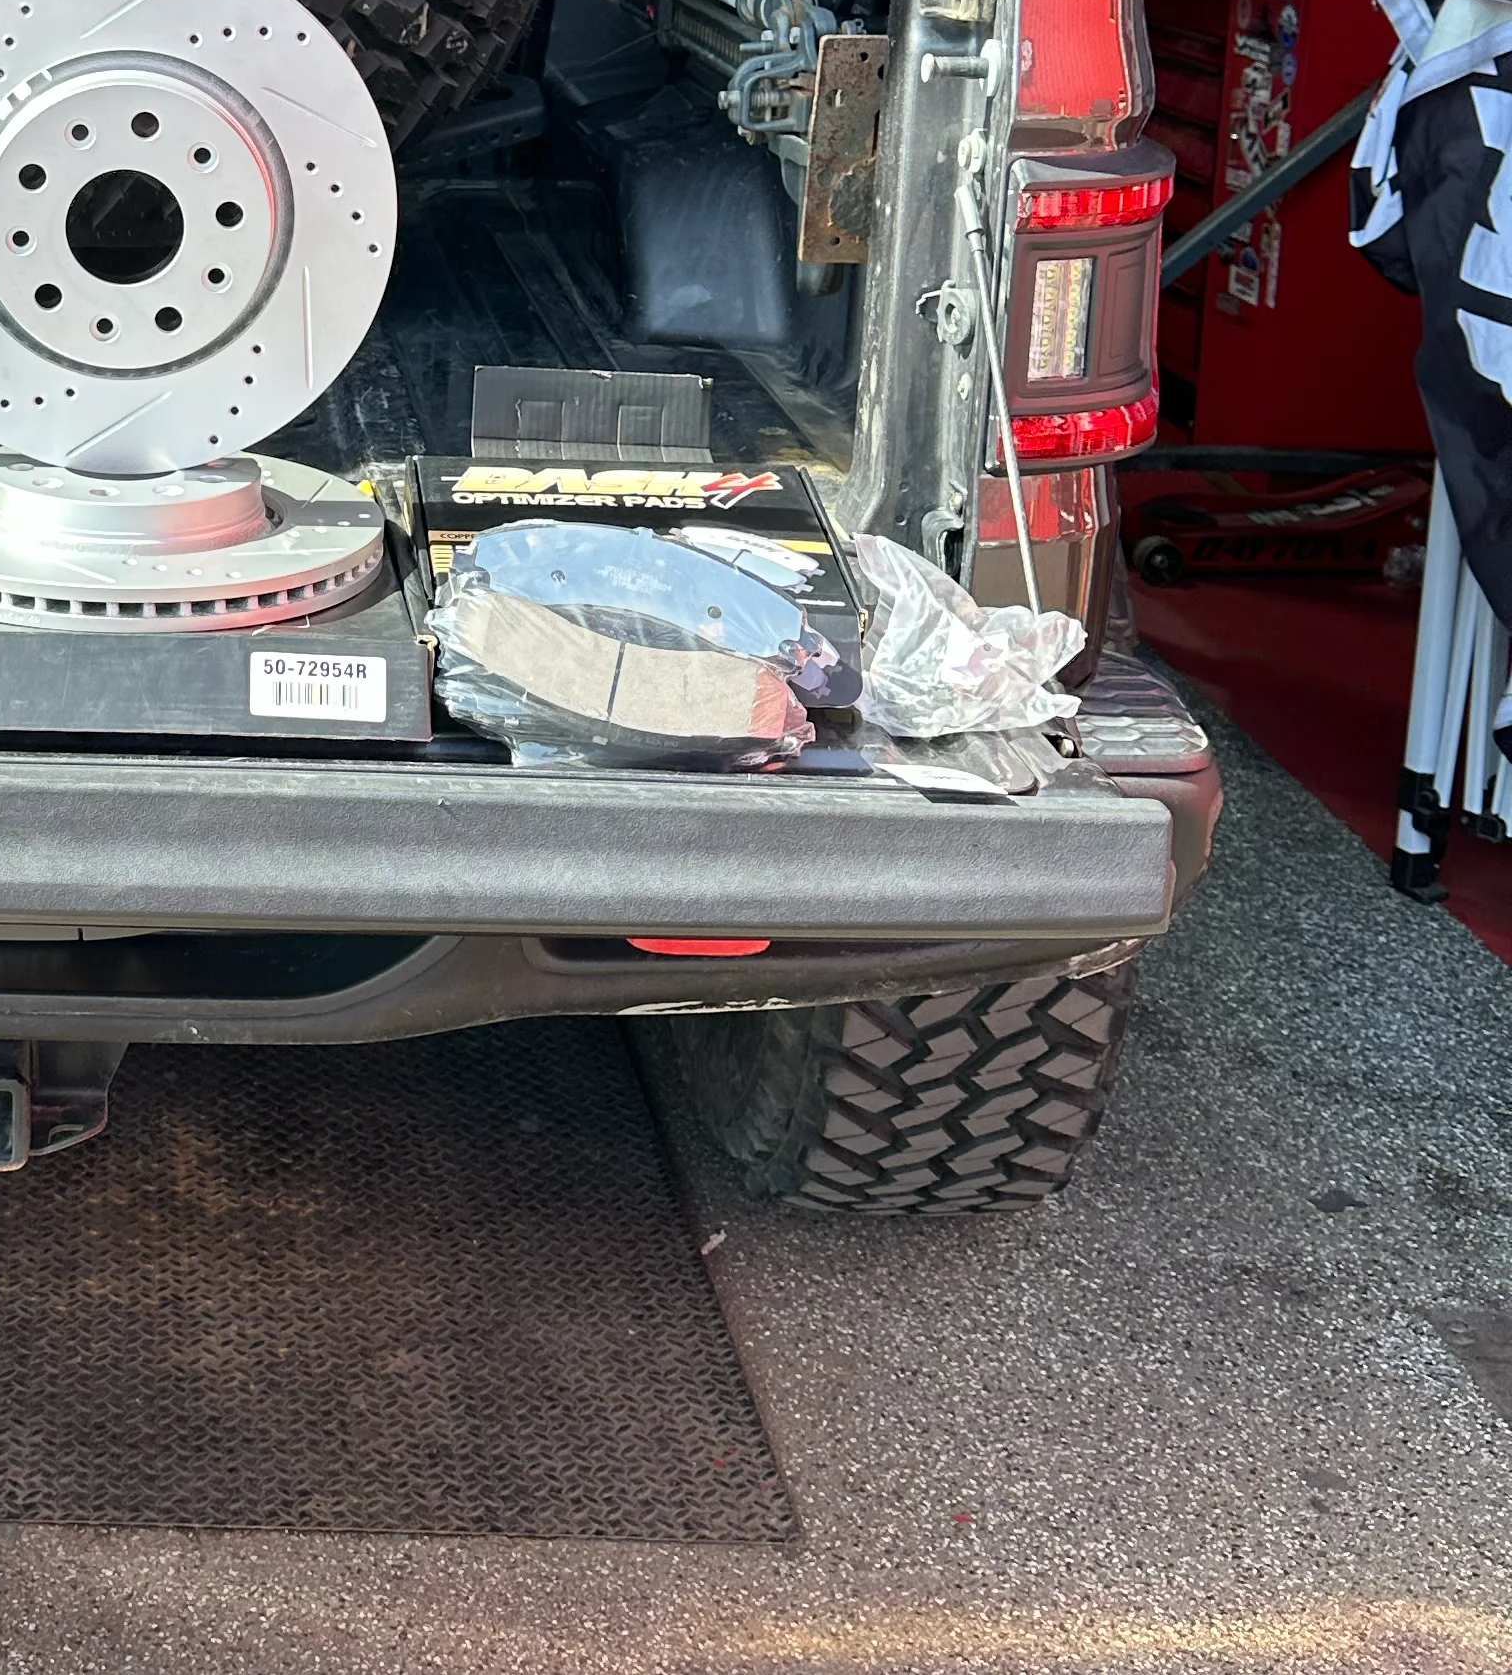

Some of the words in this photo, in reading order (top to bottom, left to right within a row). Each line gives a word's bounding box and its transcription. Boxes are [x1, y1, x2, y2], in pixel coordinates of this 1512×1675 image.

[452, 492, 618, 507] OPTIMIZER
[625, 495, 707, 509] PADS
[439, 532, 476, 540] COPPE
[1188, 536, 1380, 562] DAYTONA
[263, 659, 367, 679] 50-72954R
